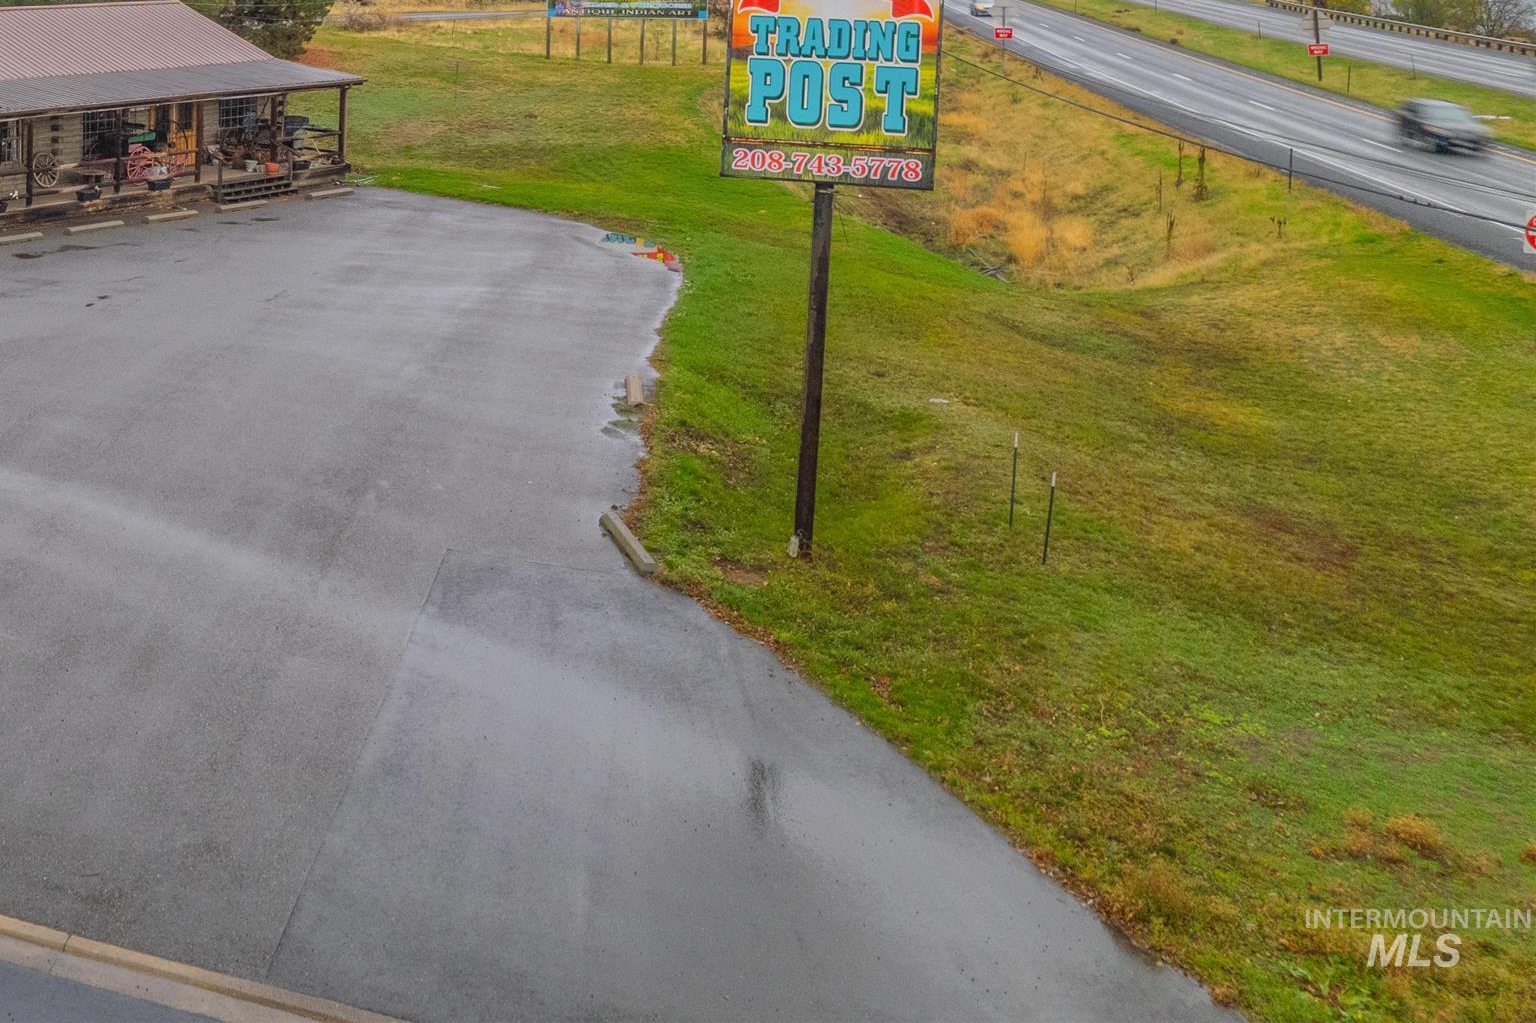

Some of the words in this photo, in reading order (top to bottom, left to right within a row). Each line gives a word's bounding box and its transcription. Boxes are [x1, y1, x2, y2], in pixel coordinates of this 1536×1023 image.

[750, 15, 921, 63] TRADING
[746, 58, 920, 134] POST
[732, 148, 922, 181] 208-743-5778
